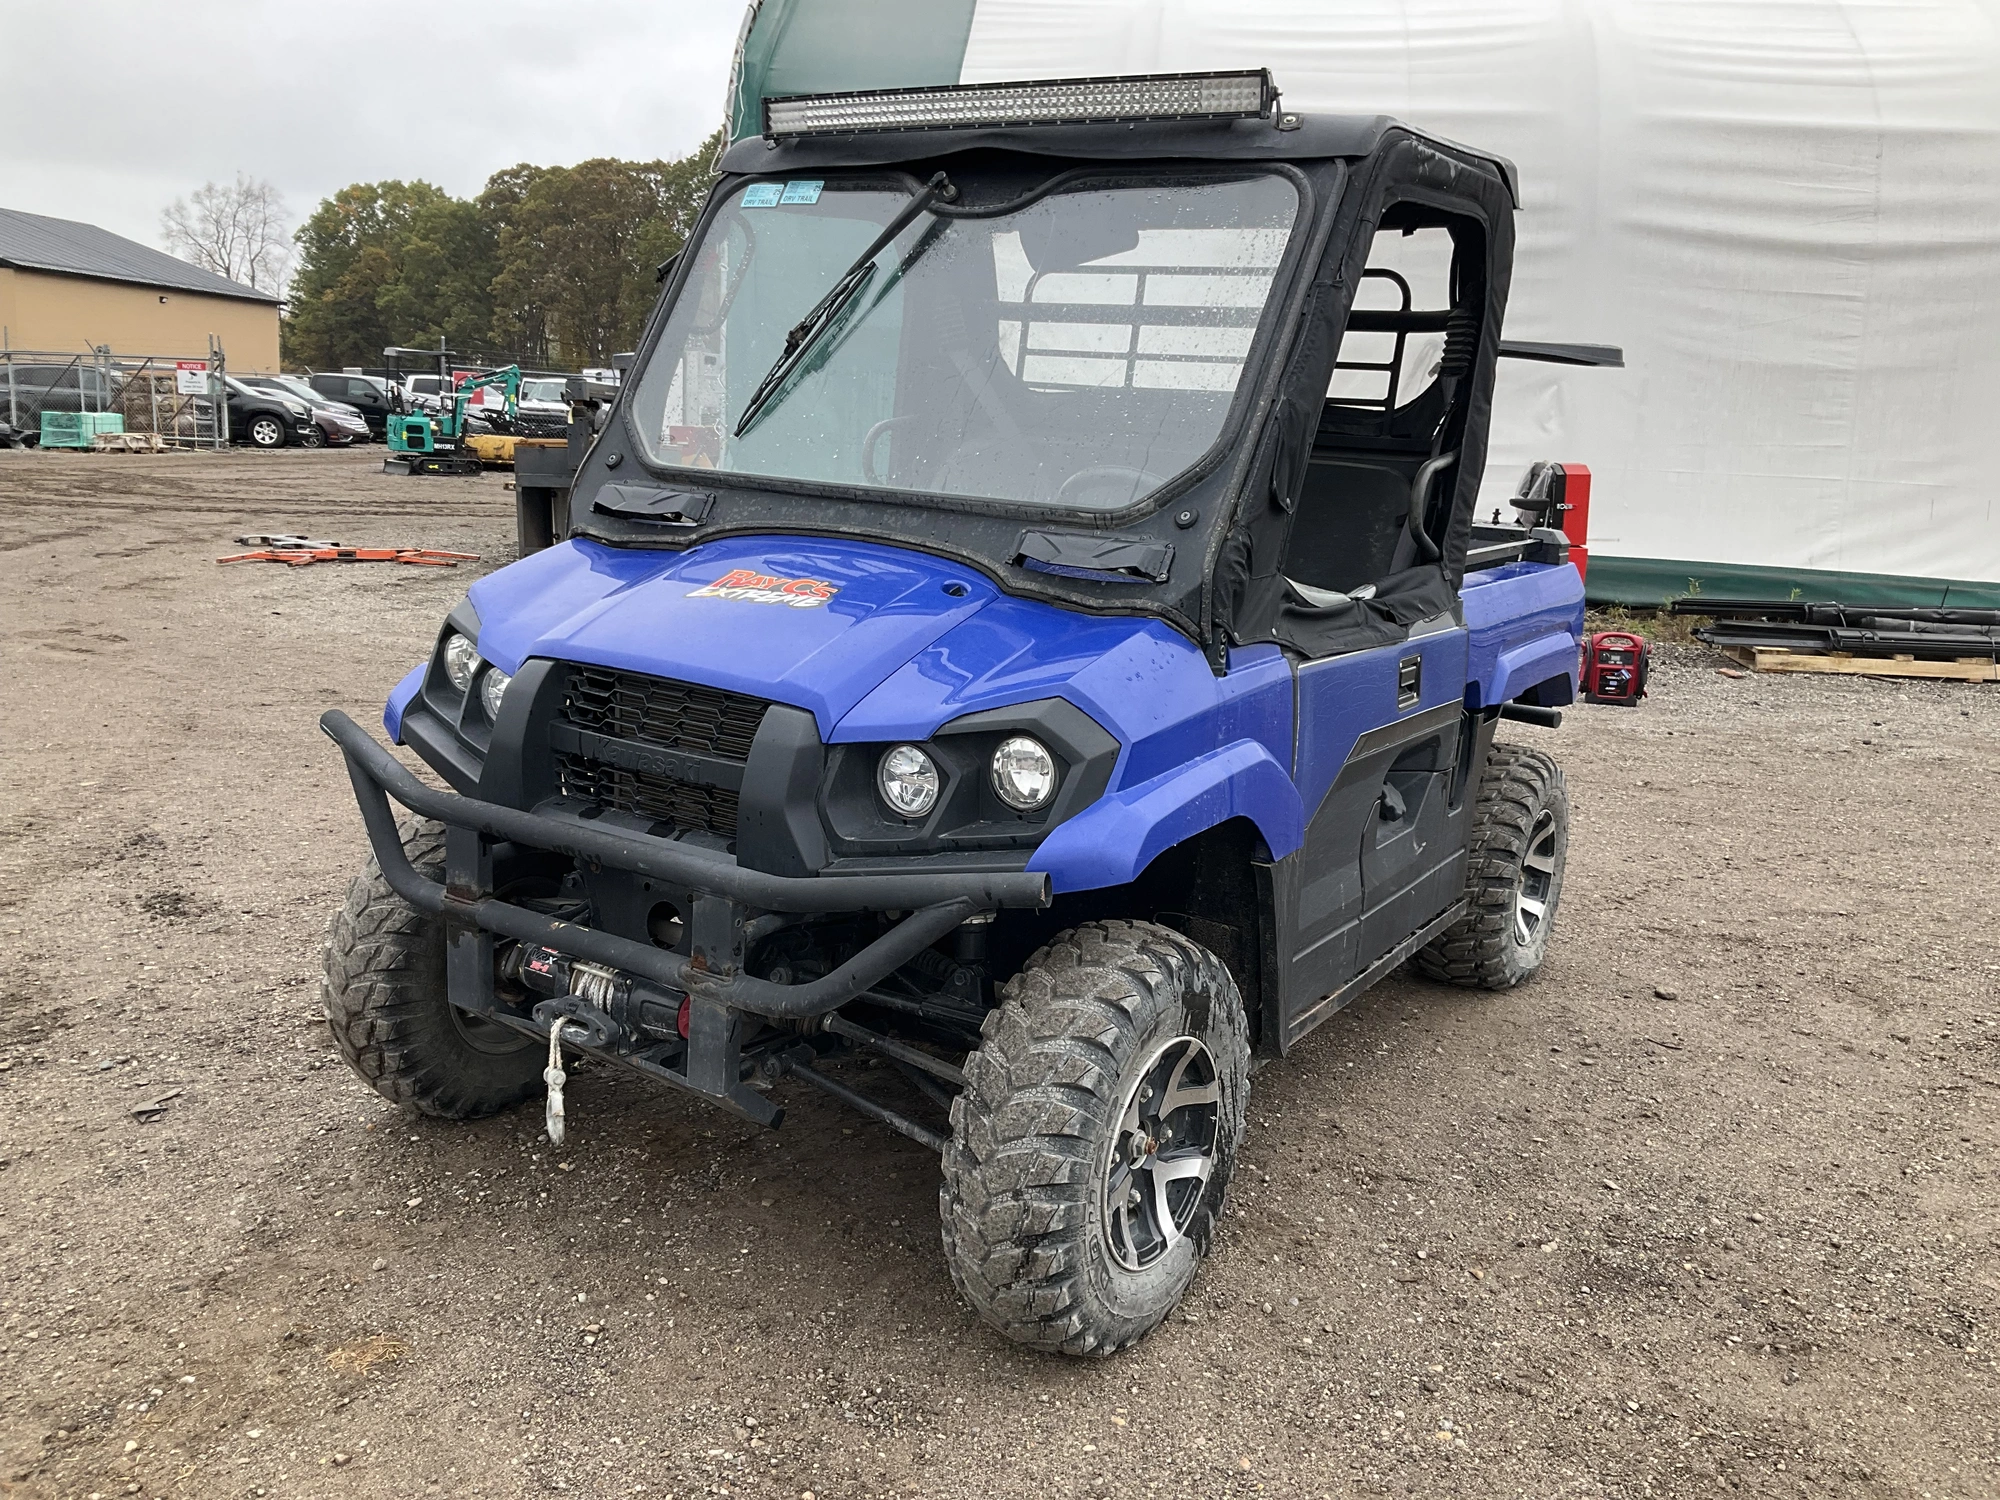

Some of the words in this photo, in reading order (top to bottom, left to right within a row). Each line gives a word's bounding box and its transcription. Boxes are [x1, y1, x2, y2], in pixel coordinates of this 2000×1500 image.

[710, 569, 793, 590] RAY
[685, 586, 829, 608] EXTREME
[592, 735, 702, 784] Kawasaki
[530, 948, 558, 965] VRX
